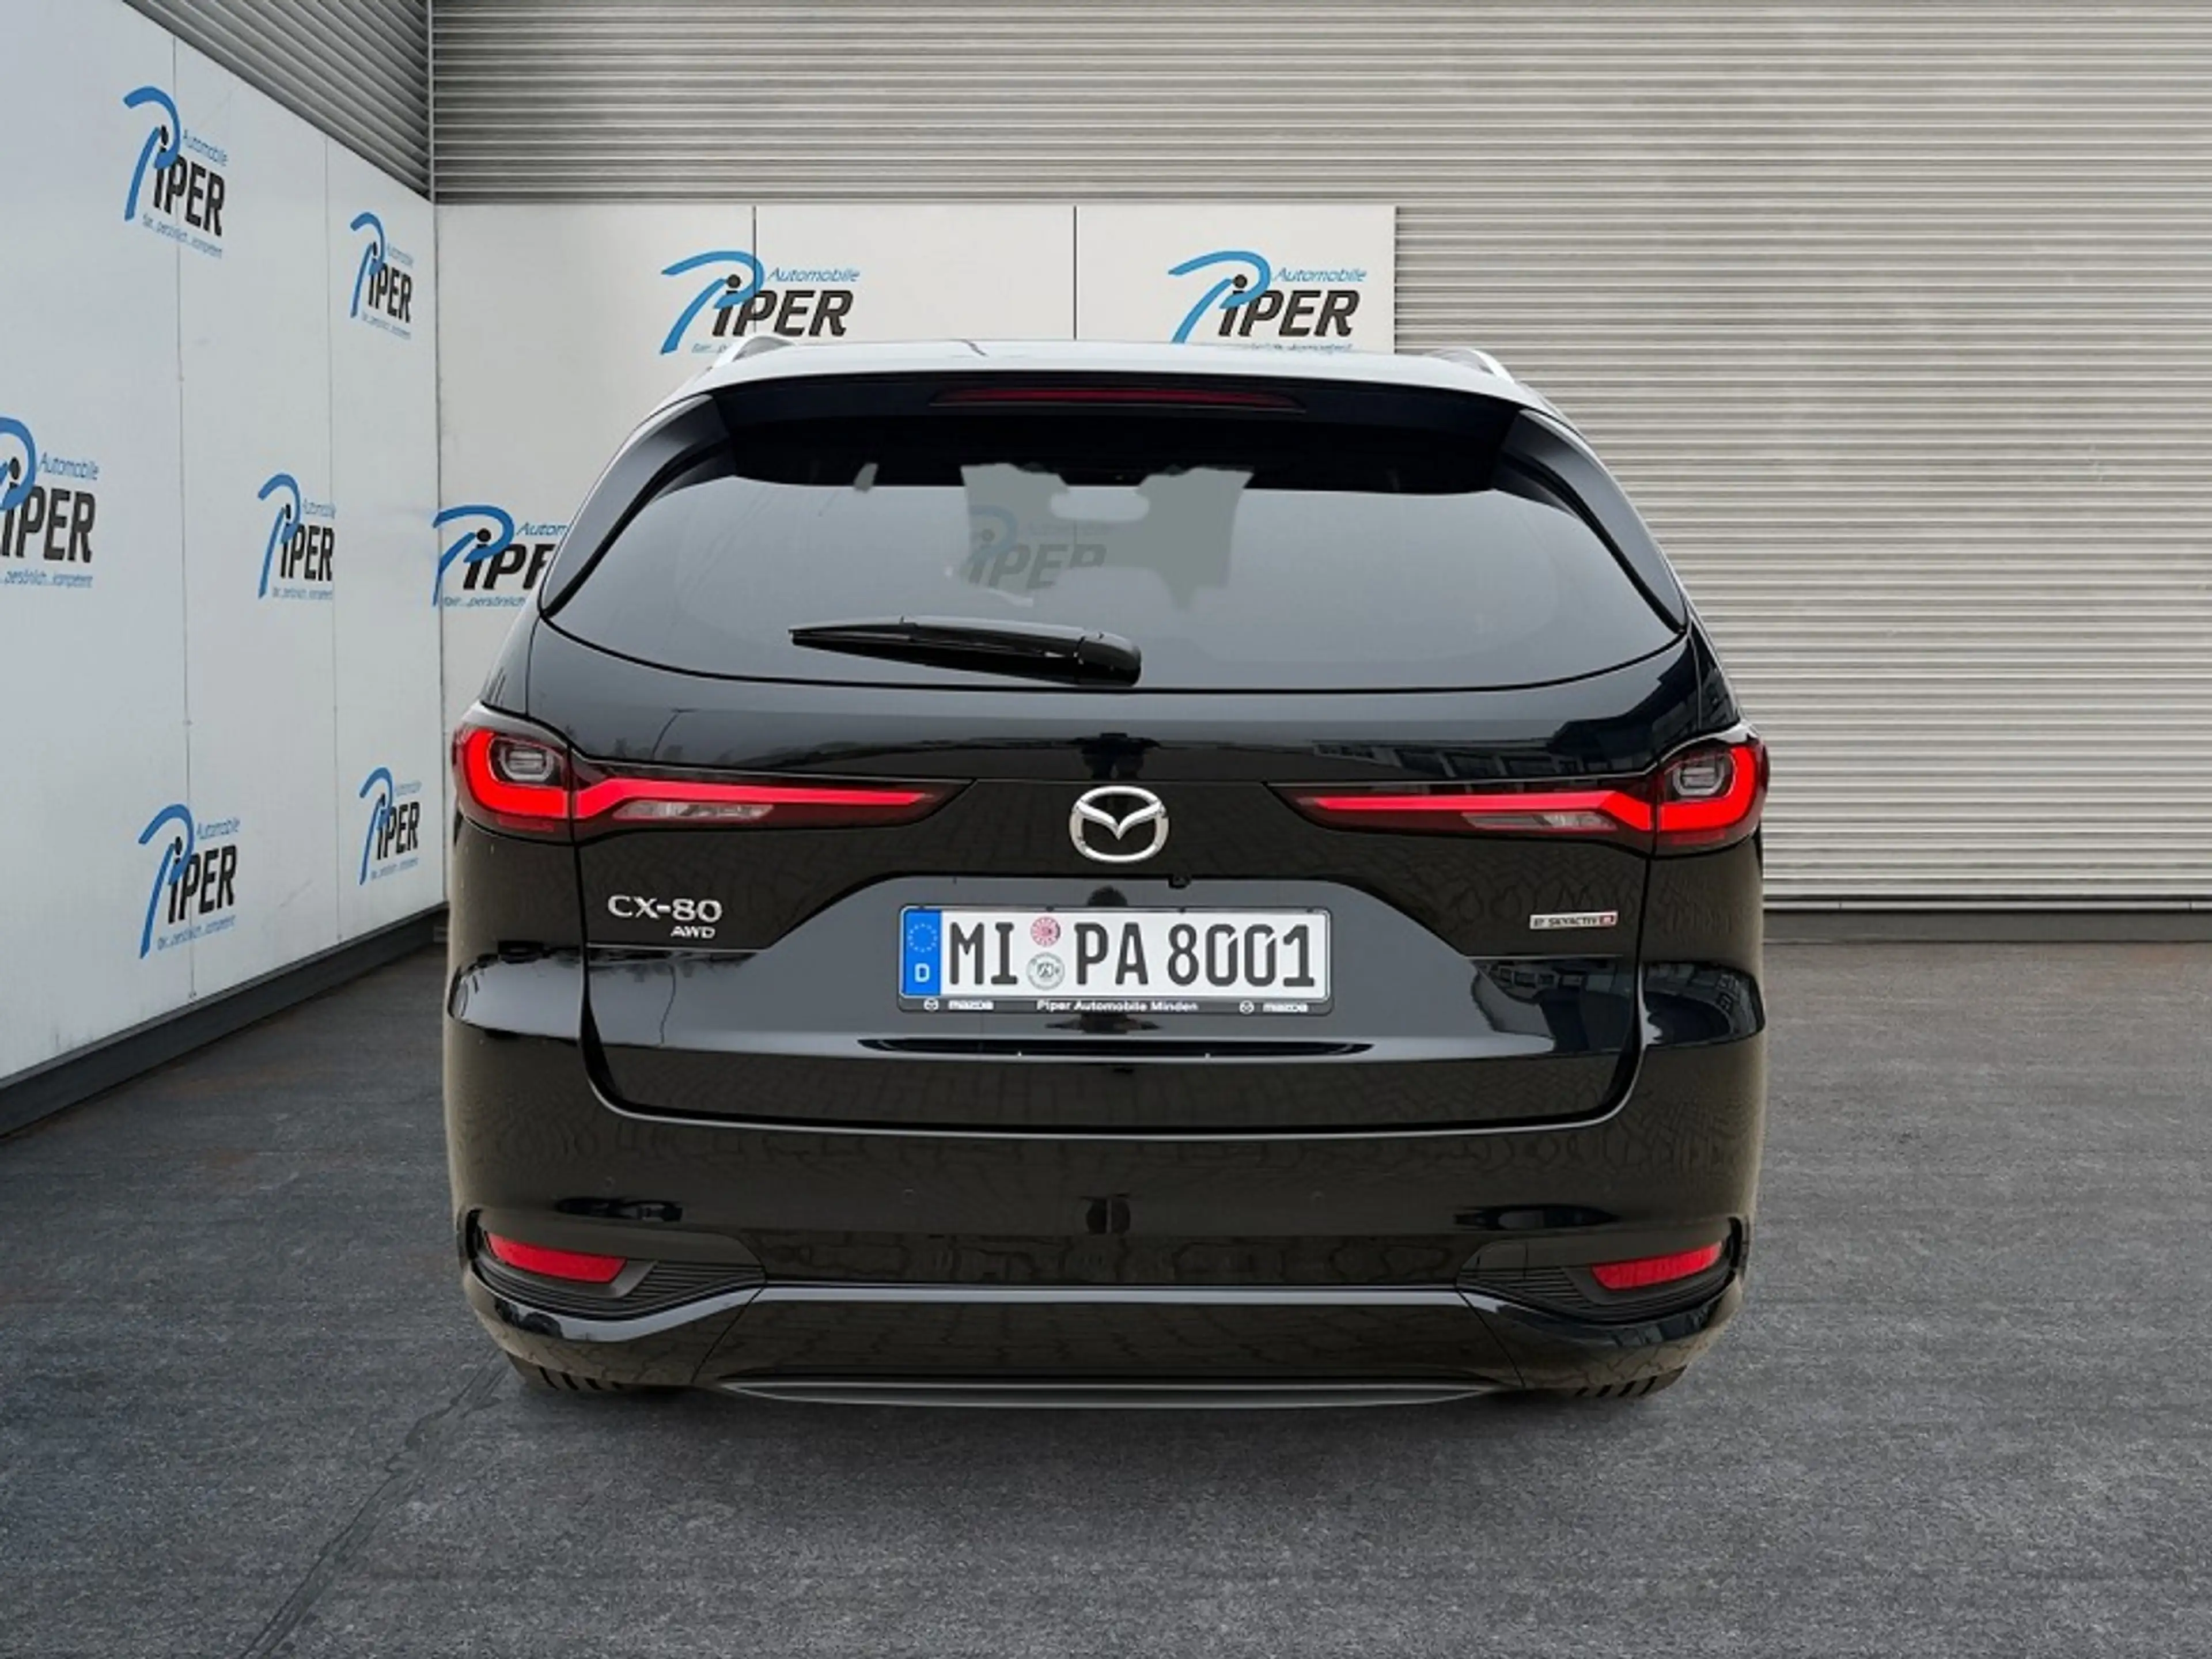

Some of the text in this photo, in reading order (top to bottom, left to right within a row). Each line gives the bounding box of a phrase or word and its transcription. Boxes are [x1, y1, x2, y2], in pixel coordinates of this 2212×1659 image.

[767, 267, 860, 282] Automobile
[1274, 267, 1367, 282] Automobile
[39, 452, 99, 481] Automobile
[607, 895, 724, 923] CX-80
[670, 925, 716, 940] AWD
[949, 922, 1018, 986] MI
[1074, 922, 1149, 986] PA
[1166, 923, 1316, 987] 8001
[914, 964, 930, 983] D
[1036, 1000, 1199, 1012] Piper Automobile Minden
